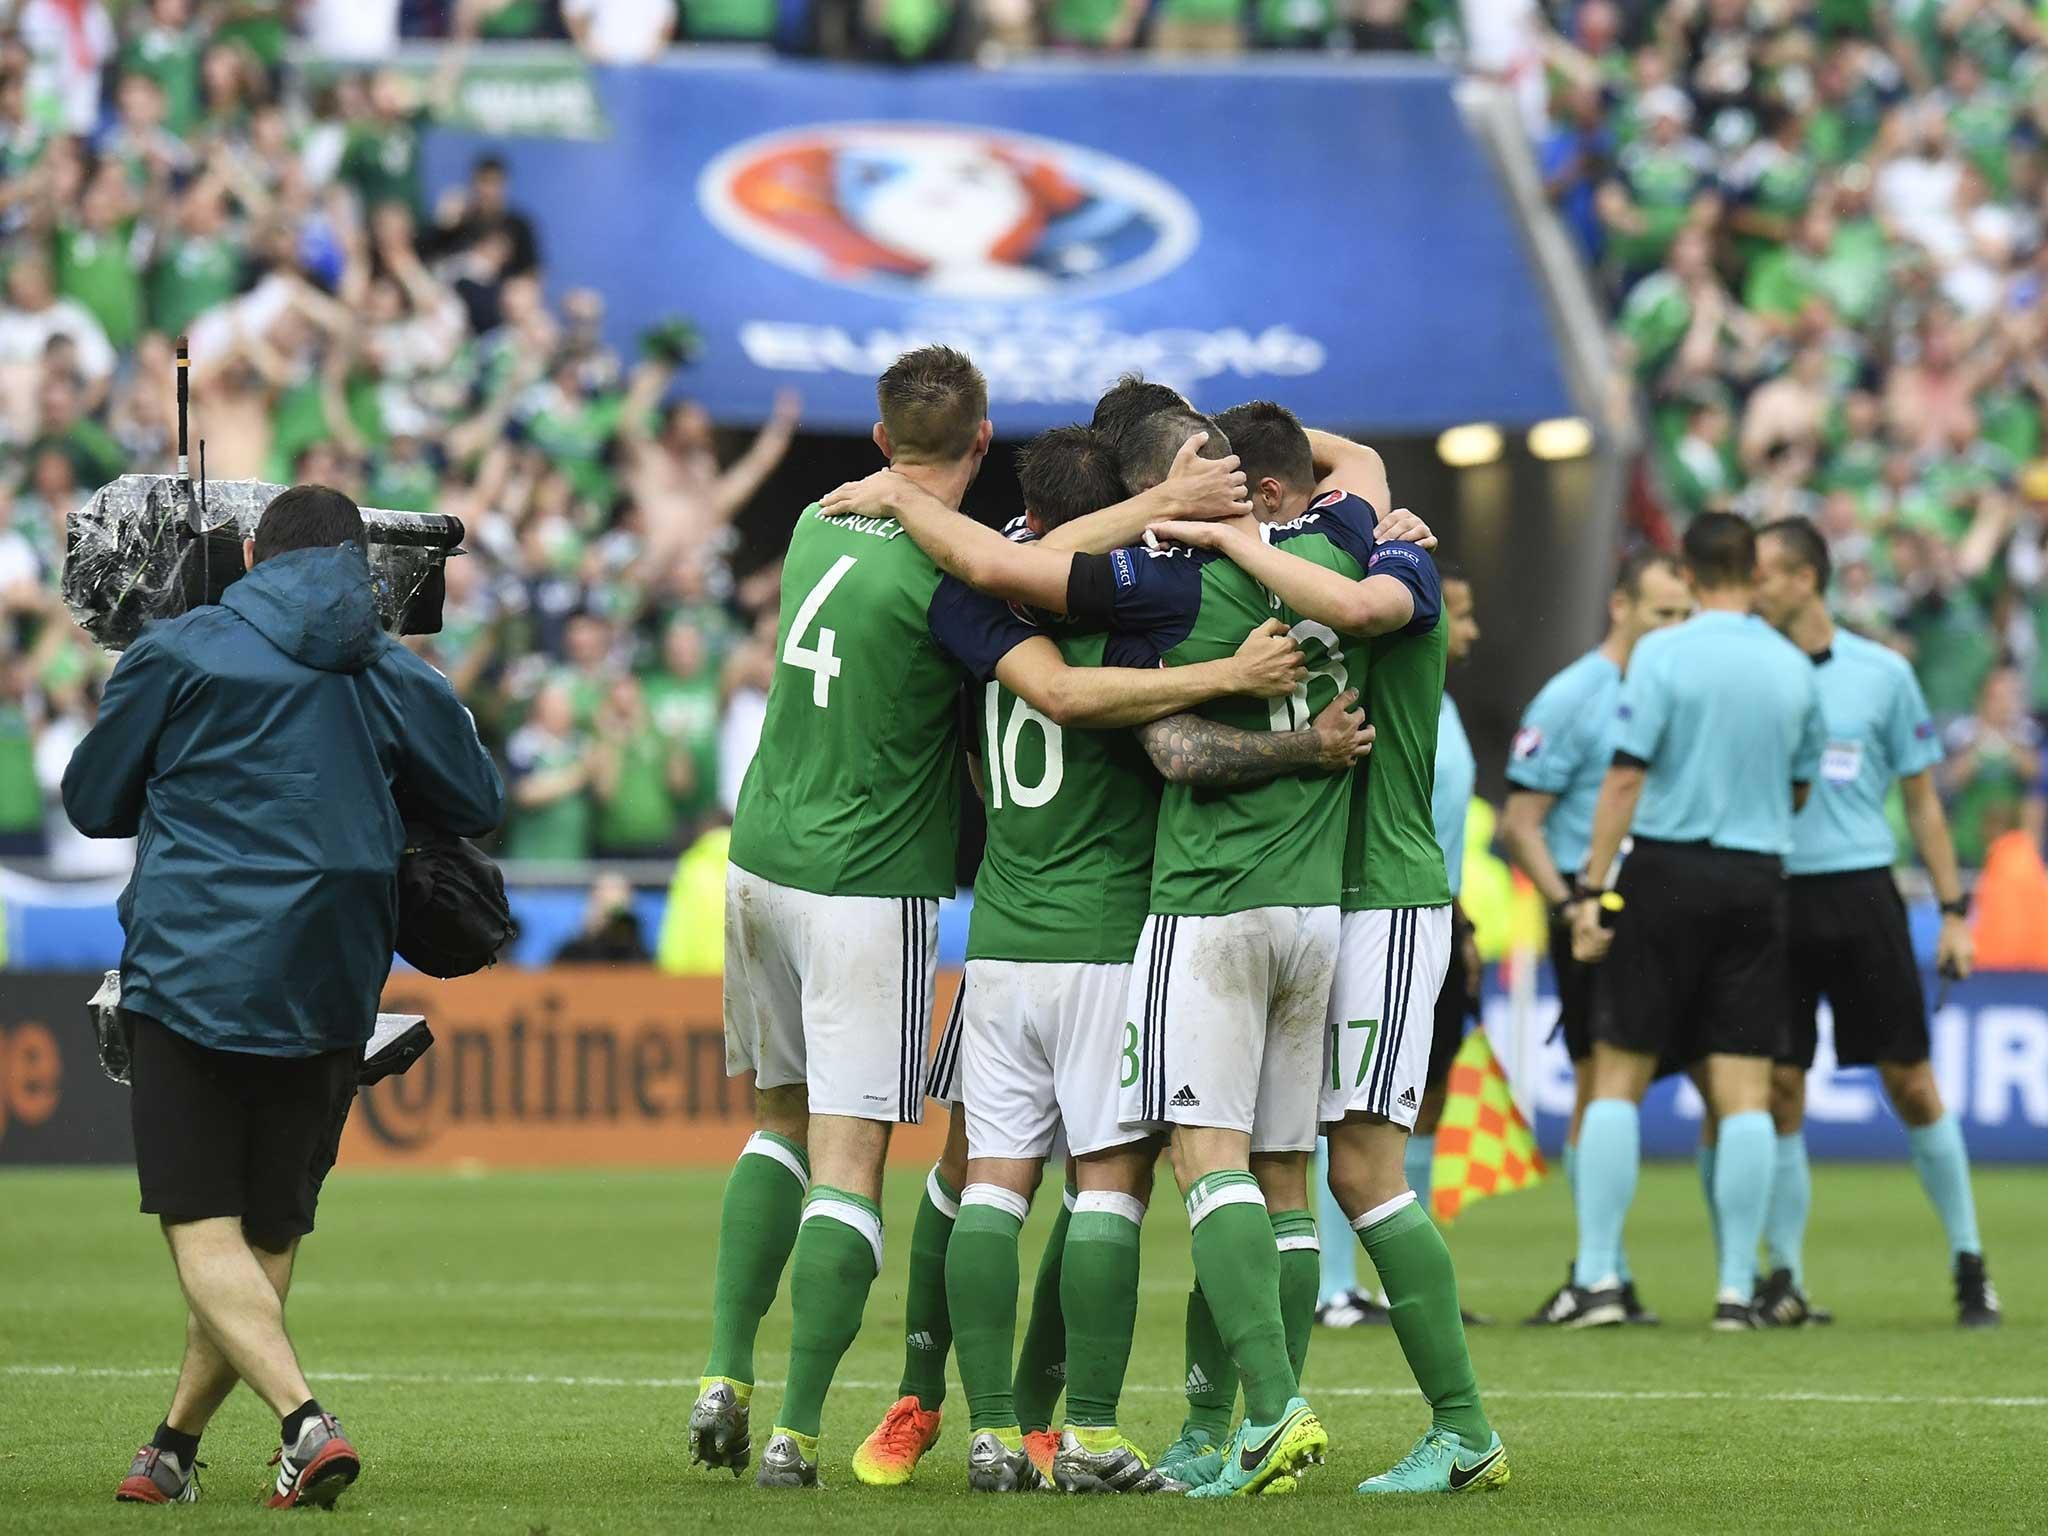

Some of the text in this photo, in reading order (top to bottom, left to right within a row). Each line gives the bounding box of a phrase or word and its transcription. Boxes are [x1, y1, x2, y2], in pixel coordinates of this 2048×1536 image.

[1116, 552, 1131, 586] RESPECT
[1379, 549, 1420, 564] RESPECT
[782, 554, 858, 708] 4
[1331, 1019, 1379, 1091] 17
[1169, 1099, 1200, 1107] adidas
